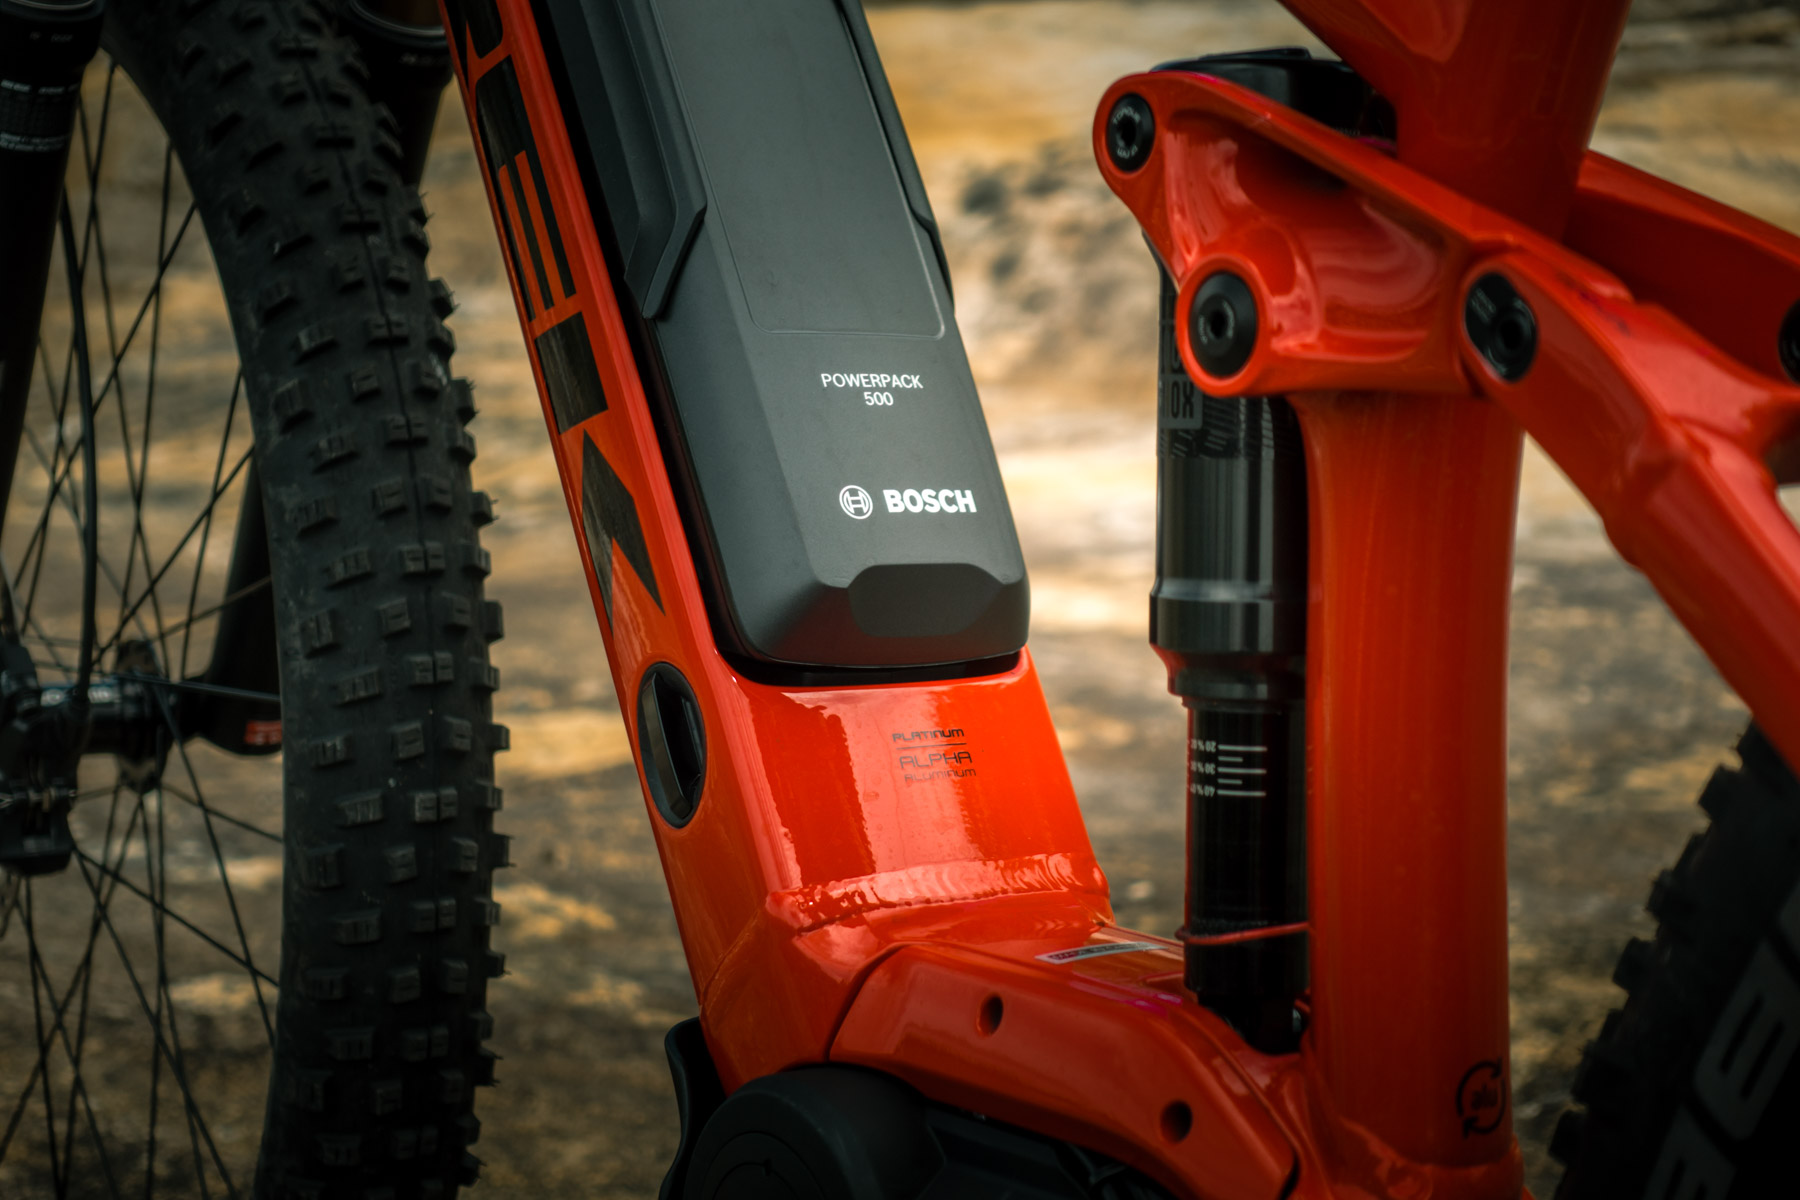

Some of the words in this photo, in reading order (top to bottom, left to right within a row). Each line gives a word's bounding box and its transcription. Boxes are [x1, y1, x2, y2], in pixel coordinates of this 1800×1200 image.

[820, 373, 924, 389] POWERPACK
[863, 391, 894, 406] 500
[882, 488, 978, 513] BOSCH
[892, 728, 965, 742] PLATINUM
[899, 751, 973, 769] ALPHA
[904, 768, 977, 783] ALUMINUM
